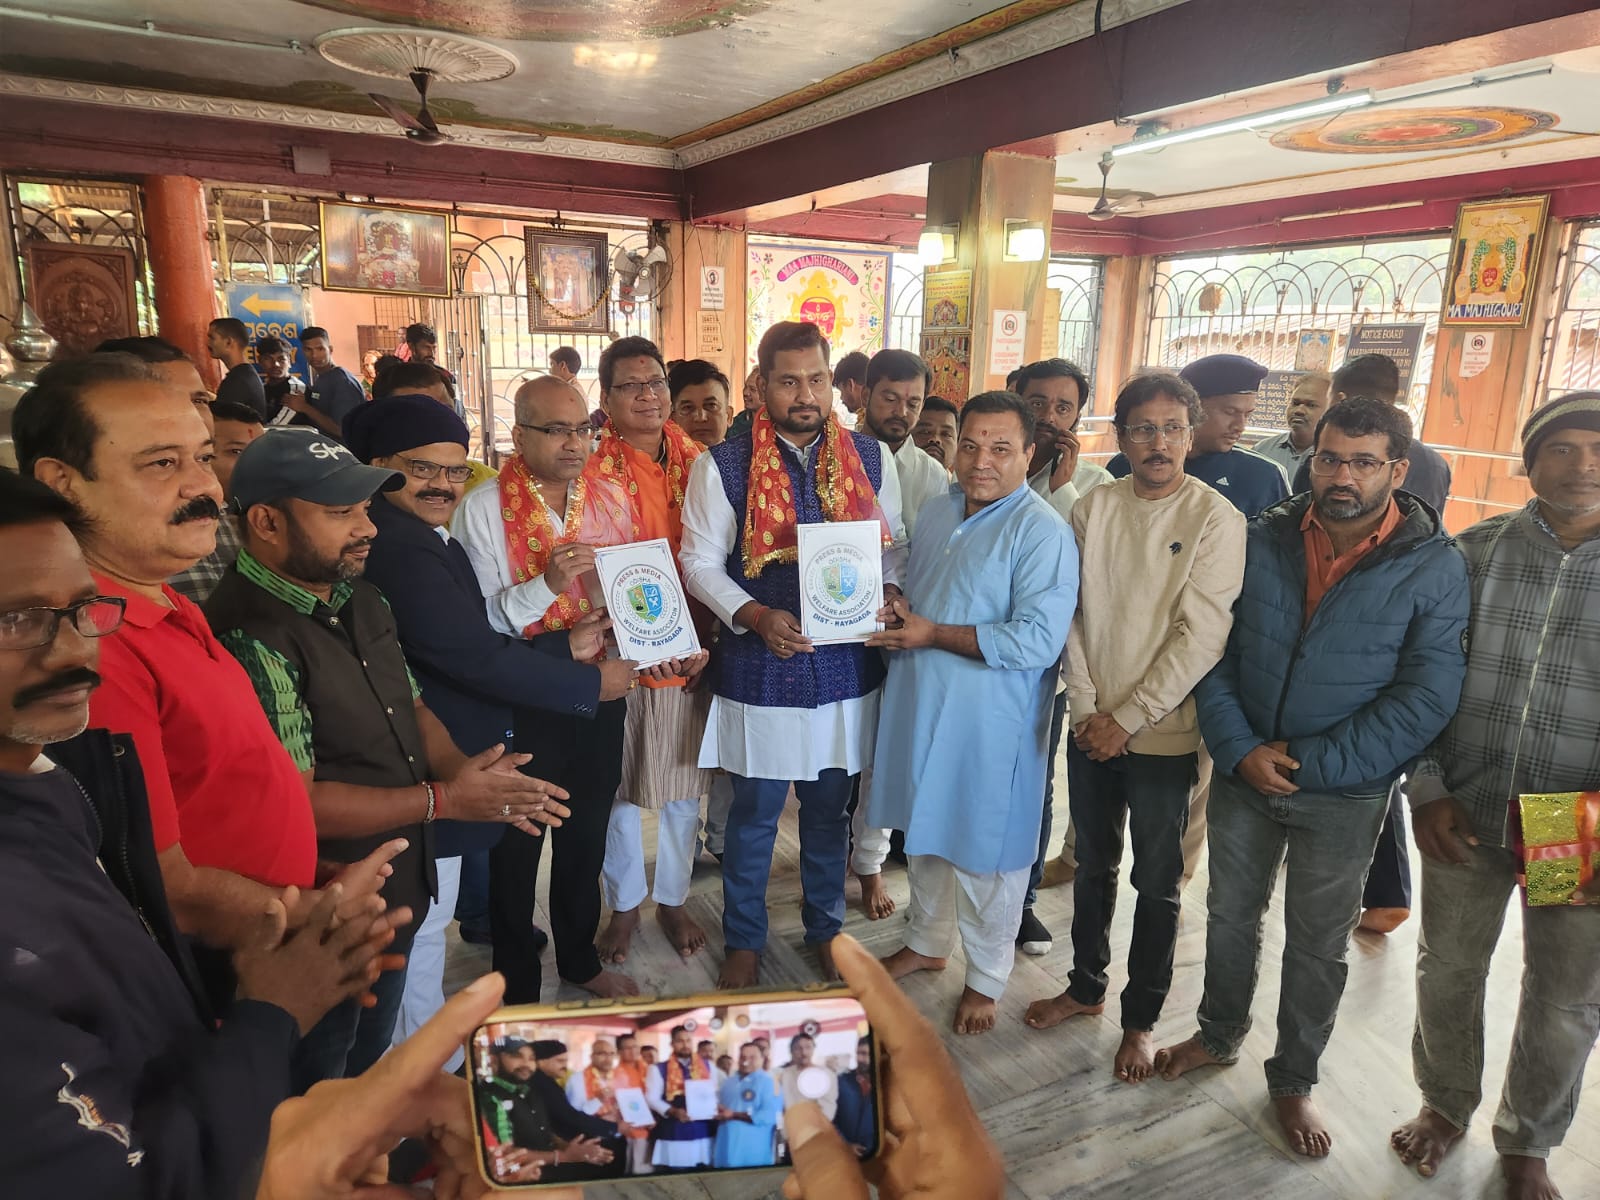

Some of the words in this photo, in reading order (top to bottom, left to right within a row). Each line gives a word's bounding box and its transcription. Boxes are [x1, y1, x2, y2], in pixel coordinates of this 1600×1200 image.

[782, 261, 800, 277] MAA
[1447, 303, 1461, 318] MA
[1360, 329, 1382, 339] NOTICE
[1383, 328, 1403, 339] BOARD
[815, 549, 835, 564] PRESS
[843, 548, 863, 560] MEDIA
[617, 570, 633, 587] PRESS
[641, 568, 662, 580] MEDIA
[812, 594, 838, 615] WELFARE
[624, 618, 651, 636] WELFARE
[813, 613, 829, 624] DIST
[834, 610, 871, 627] RAYAGADA
[629, 636, 645, 647] DIST
[652, 626, 683, 647] RAYAGADA
